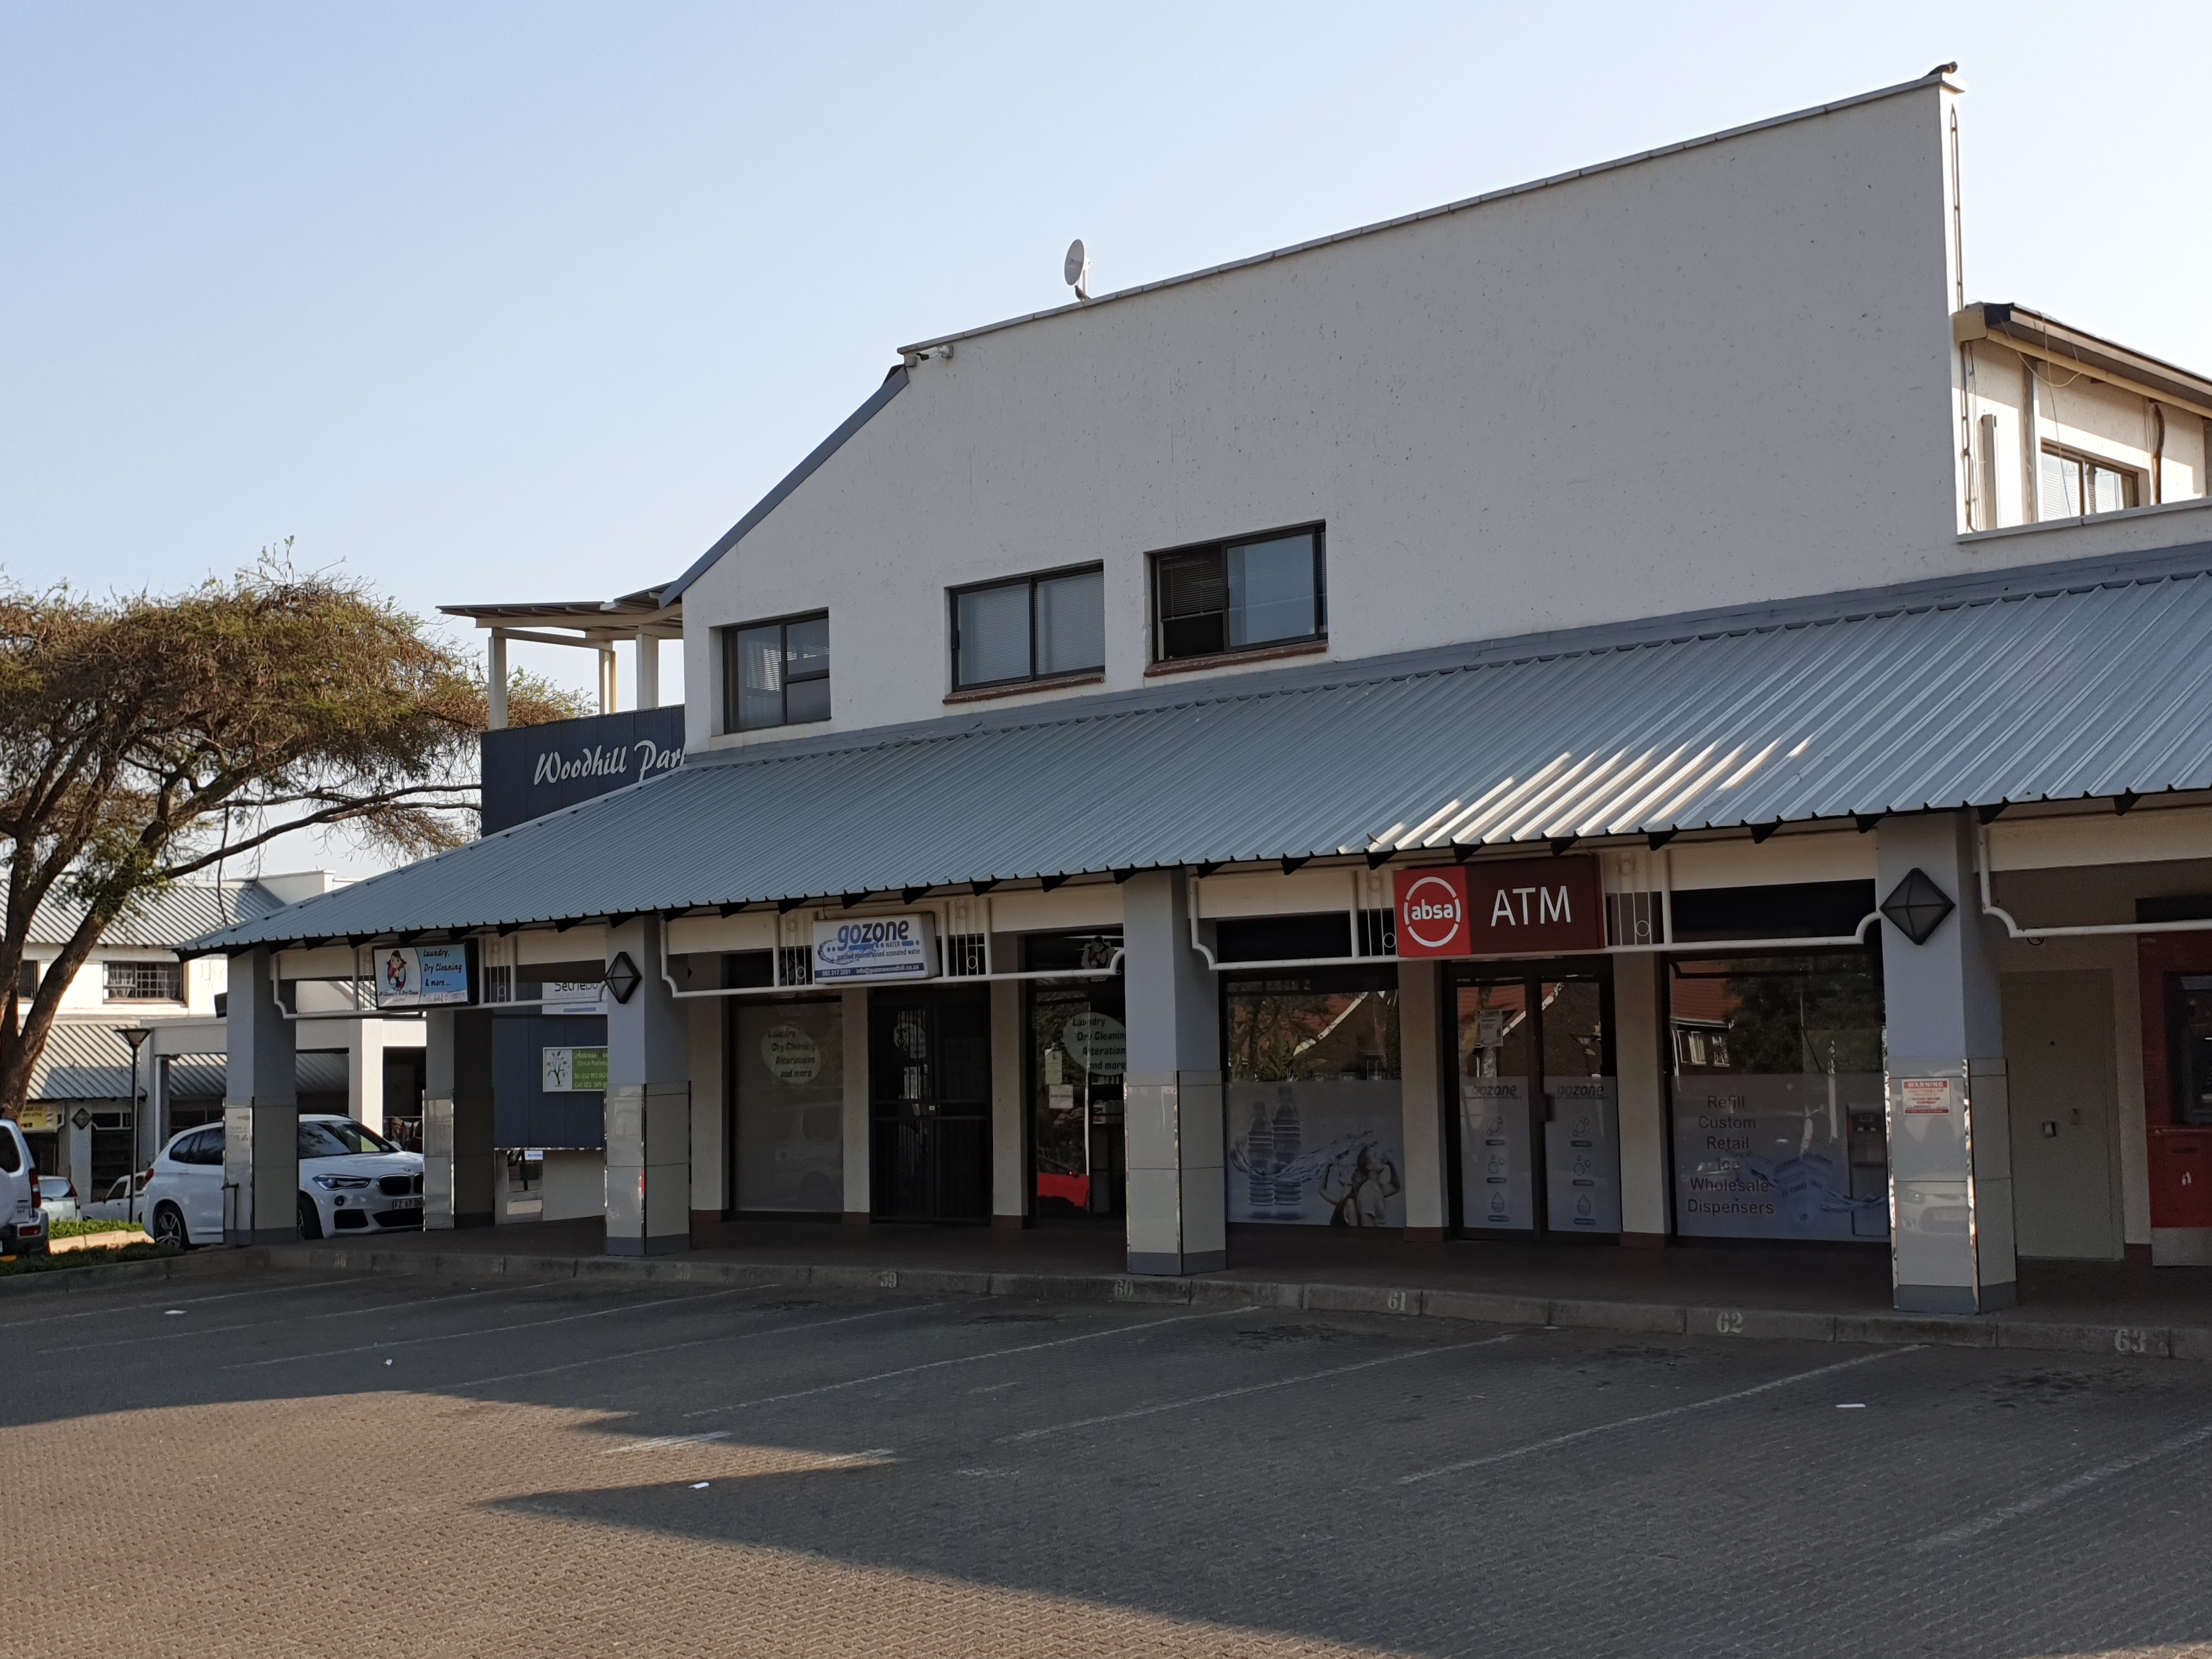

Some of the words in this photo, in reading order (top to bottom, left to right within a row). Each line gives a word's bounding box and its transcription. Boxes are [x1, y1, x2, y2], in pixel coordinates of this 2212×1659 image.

[534, 744, 627, 785] Woodhill
[1411, 899, 1454, 920] absa
[1490, 885, 1572, 927] ATM
[837, 920, 909, 951] gozone
[837, 953, 854, 961] purified
[424, 963, 435, 974] Dry
[436, 963, 462, 973] Cleaning
[856, 964, 919, 975] info@gozonewoodhill.co.za
[425, 978, 430, 986] &
[772, 1043, 783, 1052] Dry
[786, 1041, 815, 1052] Cleaning
[1082, 1046, 1125, 1056] Ateration
[775, 1056, 816, 1065] Alterations
[1708, 1095, 1745, 1108] Refill
[1699, 1115, 1756, 1128] Custom
[1707, 1136, 1748, 1149] Retail
[1718, 1157, 1740, 1170] Ice
[1690, 1177, 1769, 1192] Wholesale
[1688, 1199, 1774, 1216] Dispensers
[879, 1271, 897, 1288] 59
[1114, 1278, 1134, 1298] 60
[1387, 1291, 1406, 1311] 61
[1717, 1312, 1743, 1333] 62
[2114, 1328, 2147, 1353] 63
